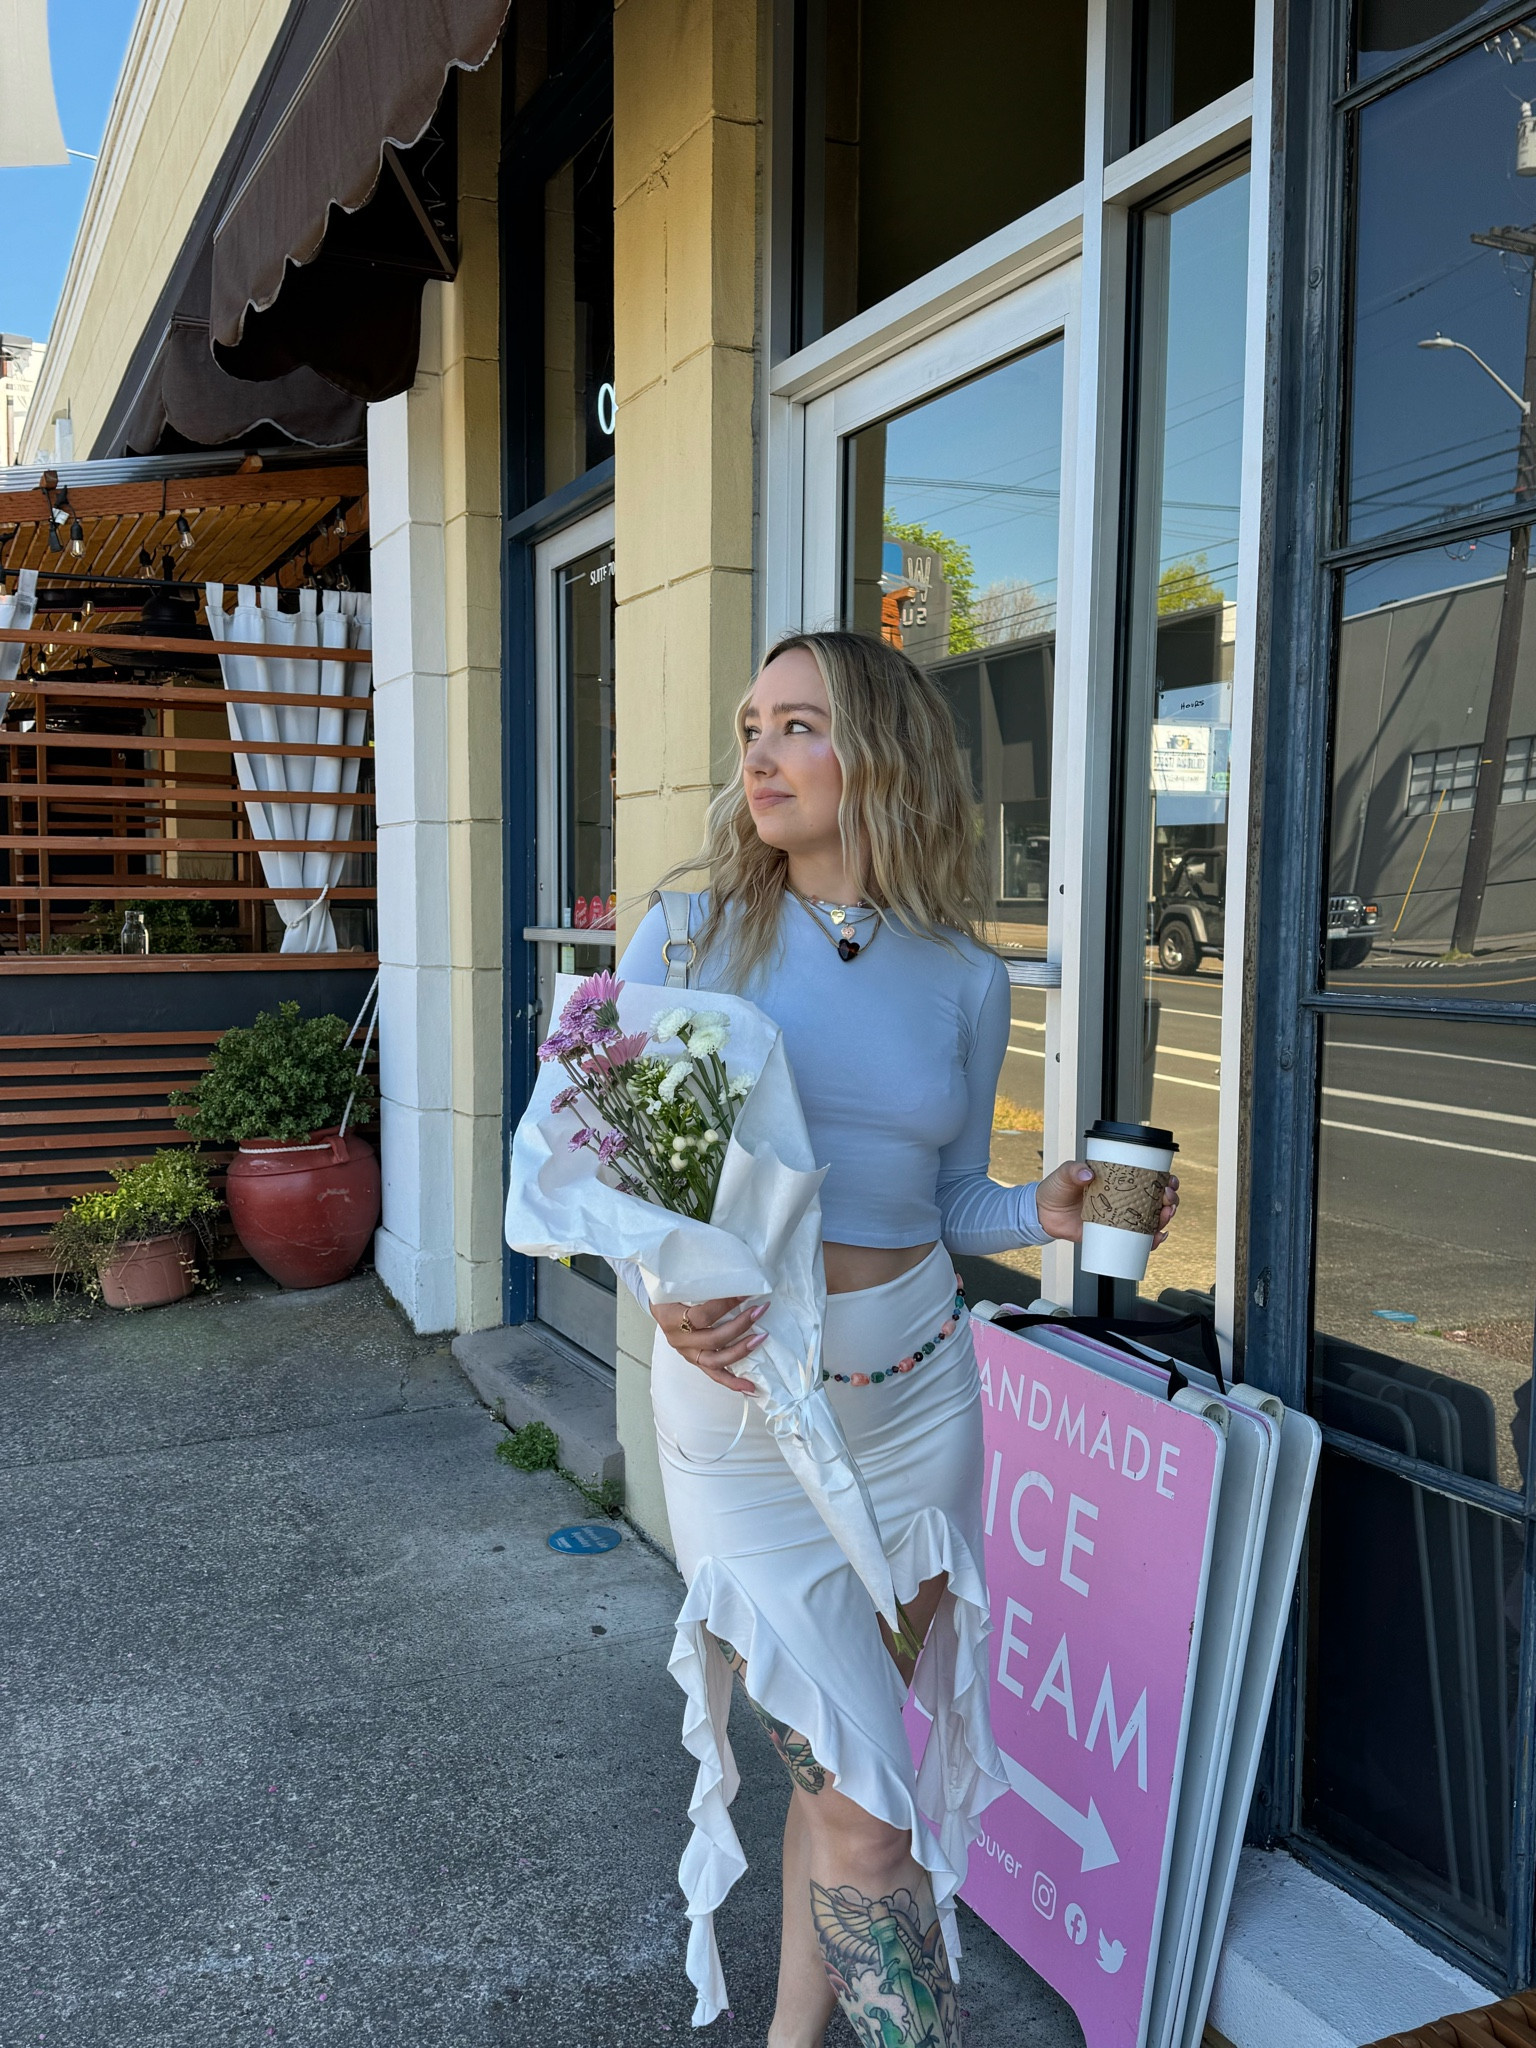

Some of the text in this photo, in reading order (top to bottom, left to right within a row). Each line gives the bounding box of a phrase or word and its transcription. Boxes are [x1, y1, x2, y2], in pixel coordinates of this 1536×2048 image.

[979, 1356, 1181, 1501] ANDMADE
[984, 1449, 1099, 1599] ICE
[996, 1595, 1148, 1794] EAM
[976, 1829, 1023, 1879] ouver
